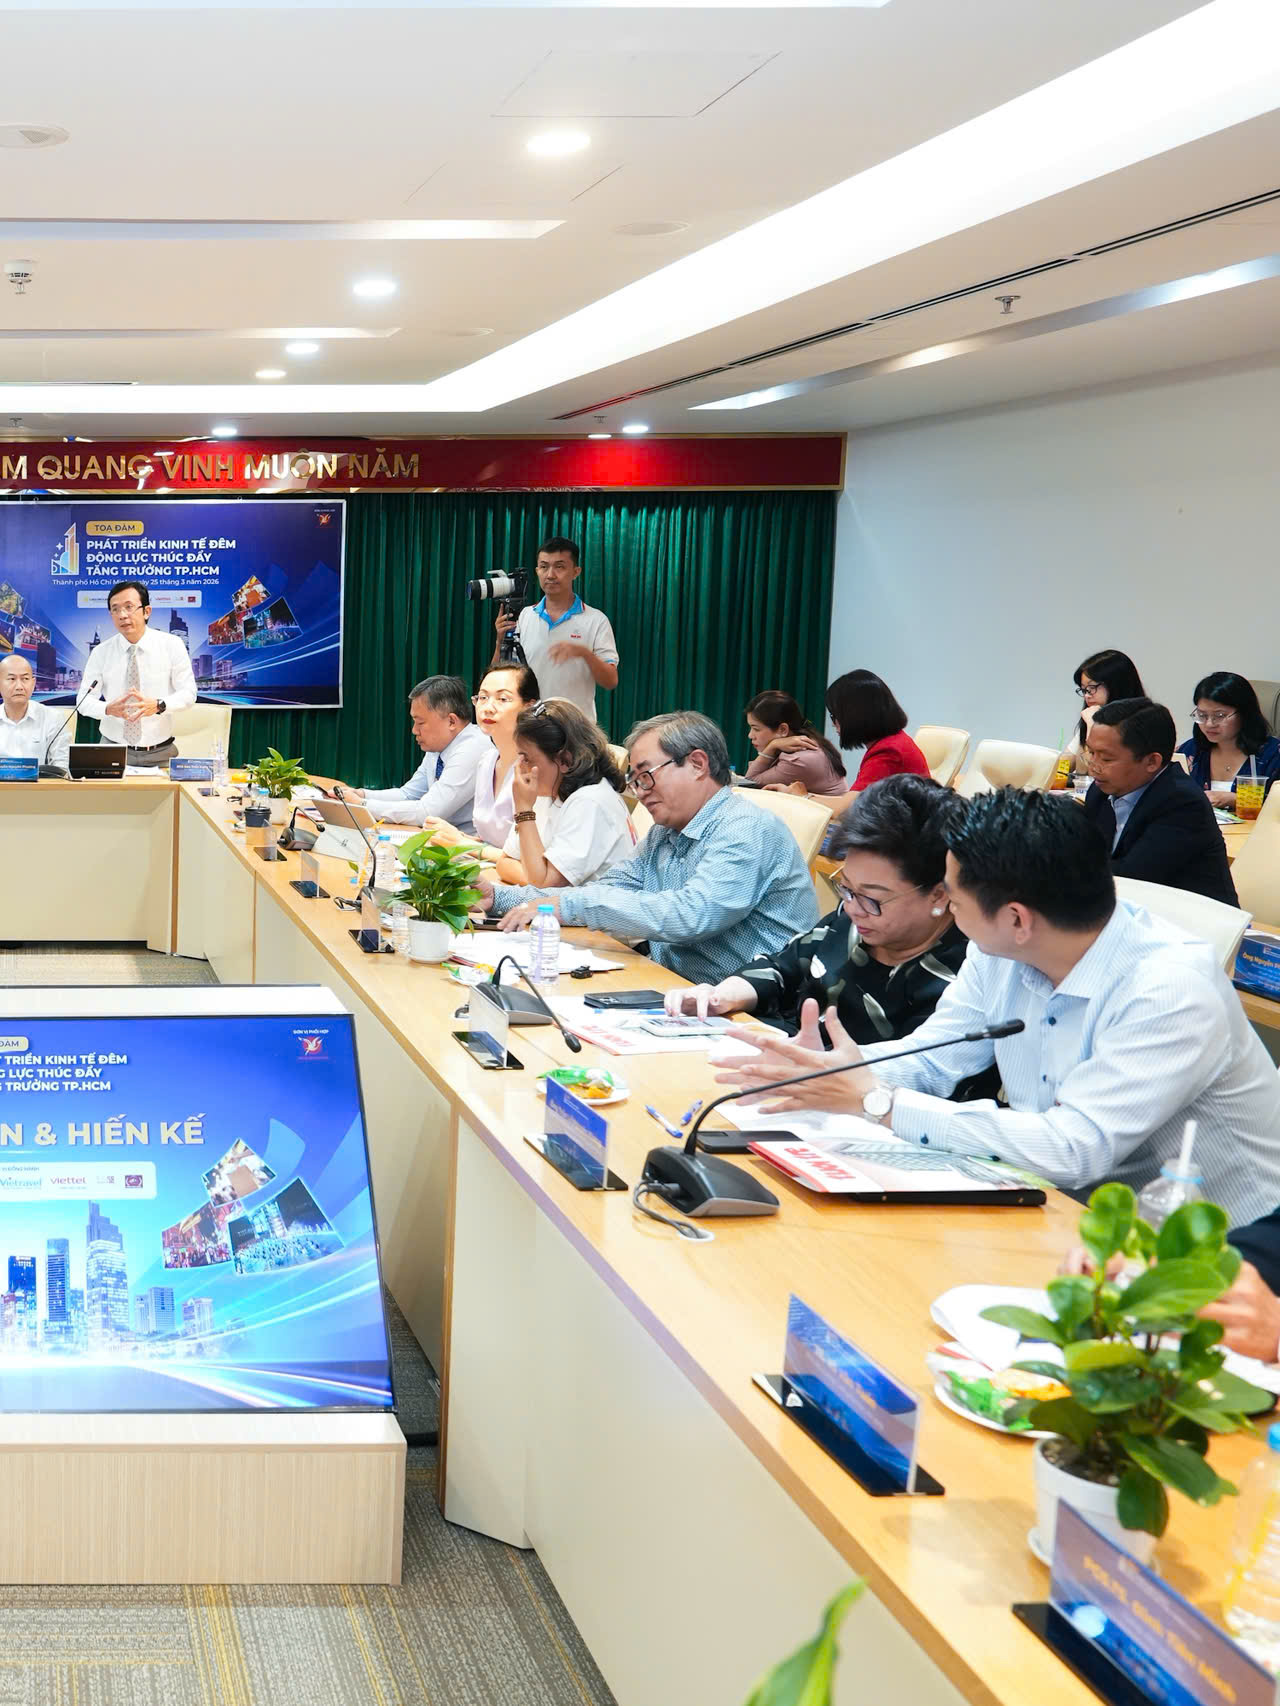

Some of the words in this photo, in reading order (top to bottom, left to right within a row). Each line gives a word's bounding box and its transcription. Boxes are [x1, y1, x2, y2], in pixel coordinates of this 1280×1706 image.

[36, 454, 154, 481] QUANG
[161, 453, 235, 481] VINH
[244, 449, 337, 479] MUÔN
[348, 448, 420, 479] NĂM
[115, 522, 136, 531] ĐÀM
[86, 538, 119, 550] PHÁT
[121, 537, 156, 550] TRIỂN
[159, 540, 189, 550] KINH
[191, 537, 207, 549] TẾ
[209, 537, 236, 549] ĐÊM
[86, 551, 122, 564] ĐỘNG
[125, 552, 148, 565] LỰC
[151, 550, 183, 562] THÚC
[186, 550, 212, 562] ĐẨY
[86, 564, 119, 576] TĂNG
[121, 563, 172, 576] TRƯỞNG
[174, 566, 219, 576] TP.HCM
[75, 578, 89, 587] phố
[4, 1052, 42, 1065] TRIỂN
[45, 1055, 77, 1065] KINH
[80, 1052, 97, 1065] TẾ
[98, 1053, 128, 1065] ĐÊM
[8, 1068, 34, 1080] LỰC
[37, 1066, 72, 1078] THÚC
[75, 1065, 103, 1078] ĐẨY
[5, 1078, 60, 1092] TRƯỞNG
[63, 1081, 112, 1091] TP.HCM
[35, 1122, 58, 1146] &
[67, 1113, 150, 1146] HIẾN
[160, 1113, 207, 1145] KẾ
[0, 1176, 42, 1187] Vietravel
